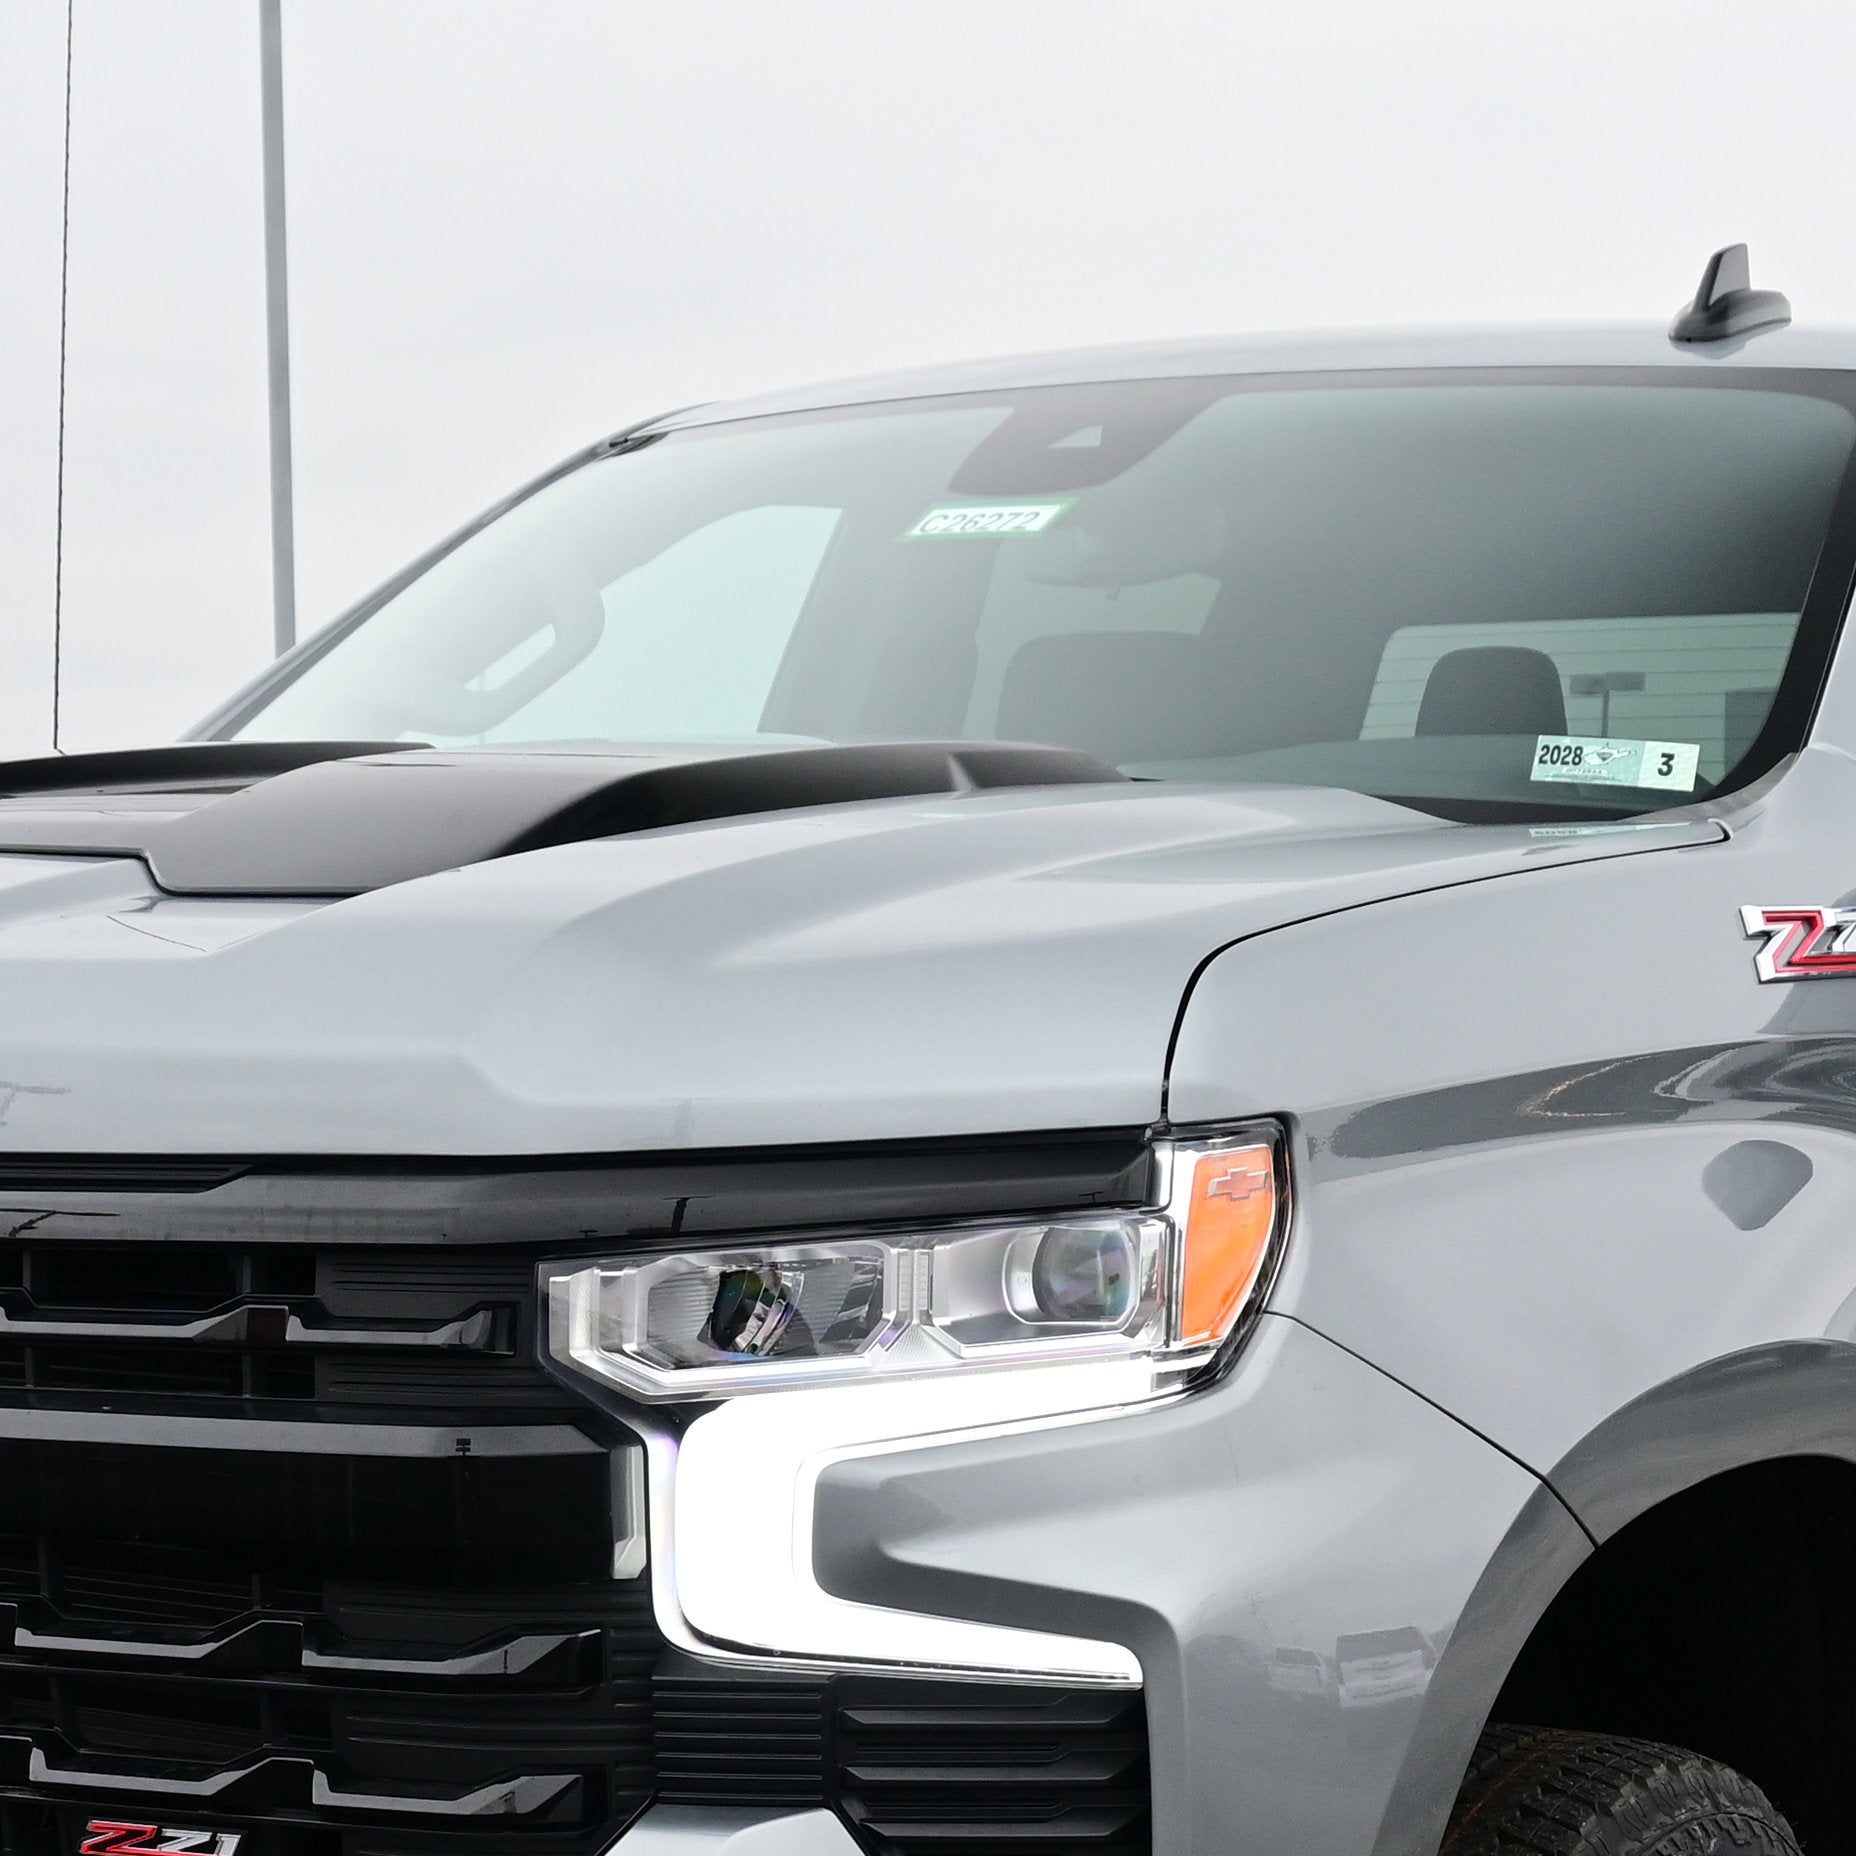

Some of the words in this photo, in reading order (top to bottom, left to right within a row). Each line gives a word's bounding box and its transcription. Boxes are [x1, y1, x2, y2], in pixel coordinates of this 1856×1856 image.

[919, 511, 1041, 533] C26272
[1538, 744, 1584, 767] 2028
[1657, 753, 1676, 777] 3
